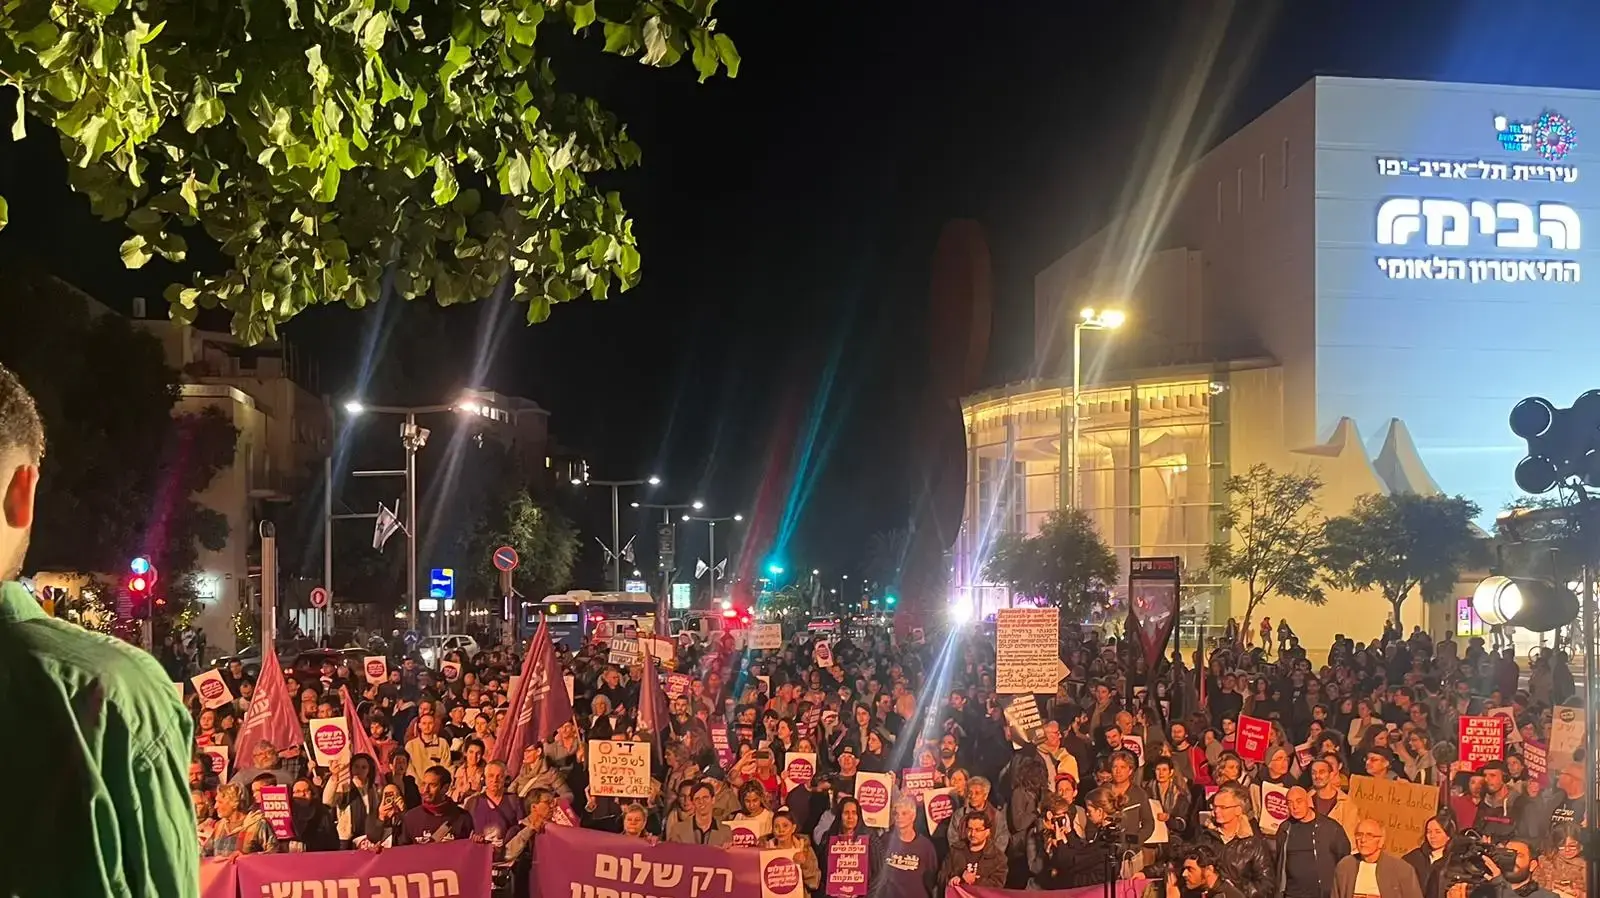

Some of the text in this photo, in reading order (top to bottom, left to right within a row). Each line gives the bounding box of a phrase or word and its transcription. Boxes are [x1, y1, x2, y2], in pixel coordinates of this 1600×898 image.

[1513, 165, 1578, 183] עיריית
[1377, 256, 1581, 283] התיאטרון הלאומי
[612, 639, 639, 653] שלום
[1469, 719, 1500, 727] יהודים
[1466, 727, 1500, 736] וערבים
[1462, 735, 1500, 744] מסרבים
[616, 743, 634, 753] די
[1472, 744, 1500, 753] להיות
[598, 756, 645, 767] לשפיכות
[1468, 753, 1500, 762] אויבים
[600, 775, 643, 785] STOP THE
[906, 780, 934, 788] הסכם
[593, 785, 614, 794] WAR
[595, 853, 684, 888] שלום
[369, 869, 460, 898] הרוב
[690, 865, 733, 898] רק
